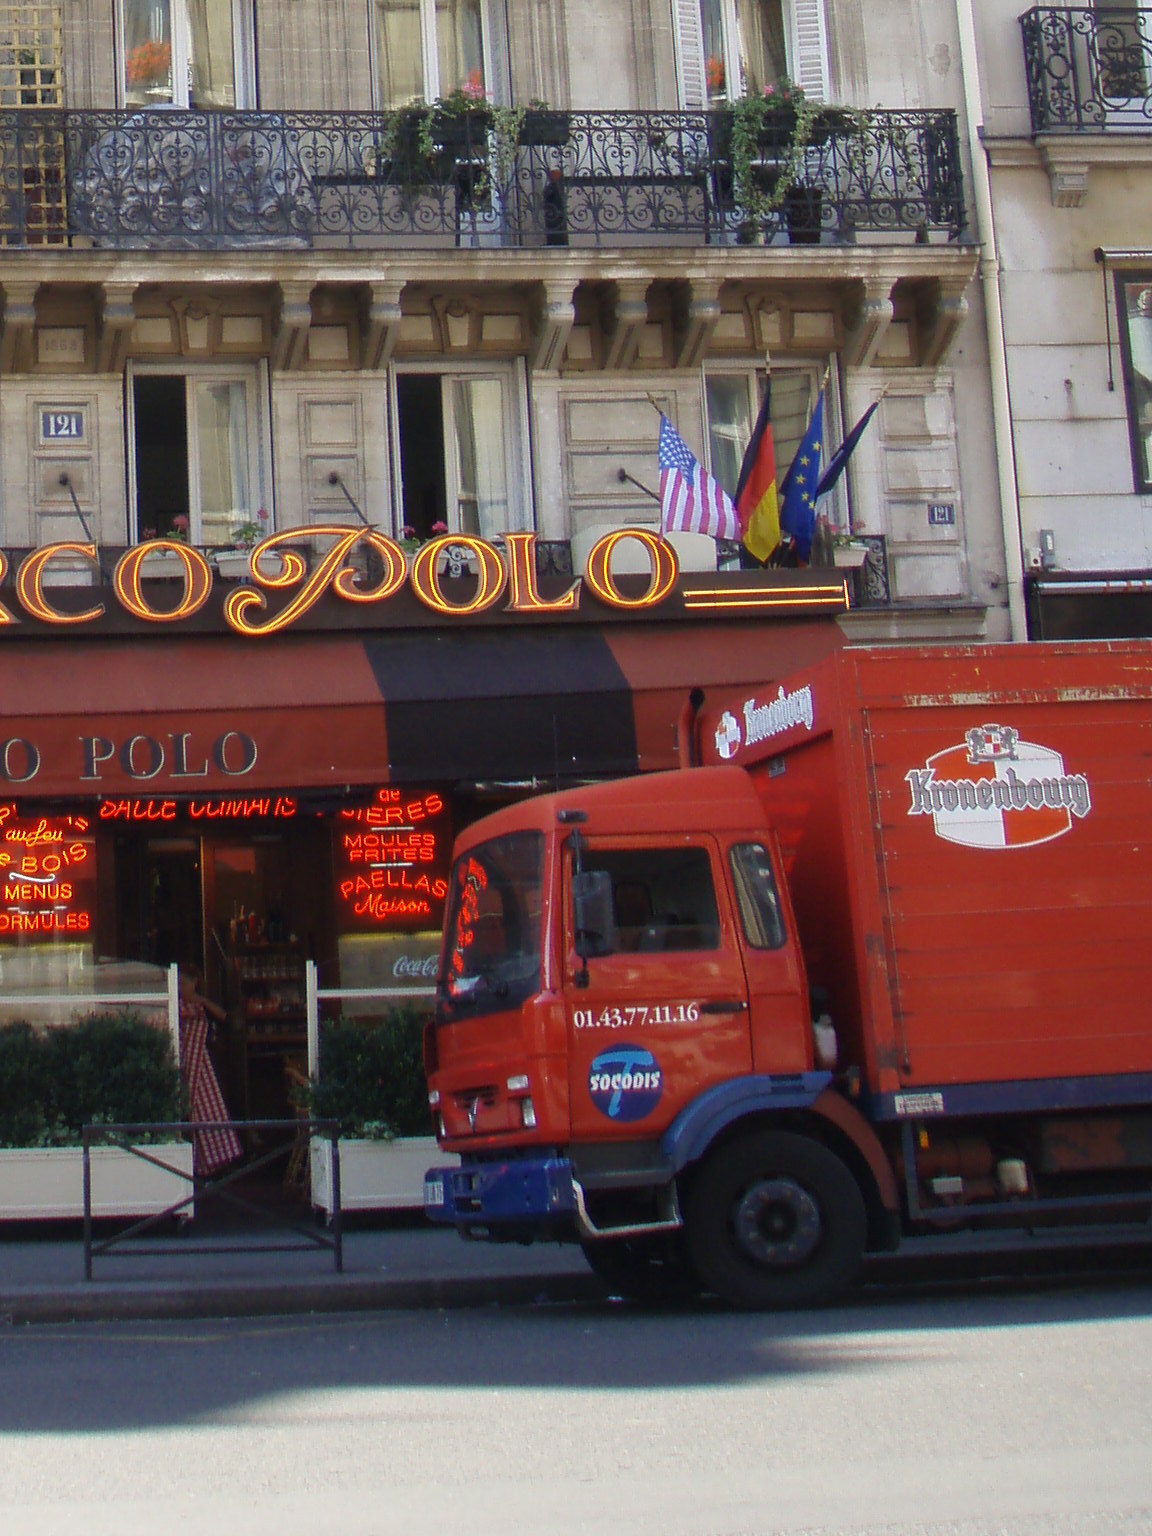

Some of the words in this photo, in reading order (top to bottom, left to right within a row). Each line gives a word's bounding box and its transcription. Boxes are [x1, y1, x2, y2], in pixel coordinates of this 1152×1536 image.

[49, 415, 77, 435] 121
[933, 506, 949, 521] 121
[223, 524, 681, 636] POLO
[78, 731, 258, 781] POLO
[904, 767, 1091, 818] Kronenbourg
[99, 799, 177, 819] SALLE
[5, 828, 29, 842] au
[25, 819, 64, 847] feu
[344, 834, 436, 849] MOULES
[21, 843, 88, 873] BOIS
[349, 848, 435, 862] FRITES
[4, 884, 73, 900] MENUS
[340, 869, 449, 899] PAELLAS
[354, 893, 431, 918] Maison
[574, 1001, 698, 1028] 01.43.77.11.16
[590, 1071, 661, 1091] SOCODIS
